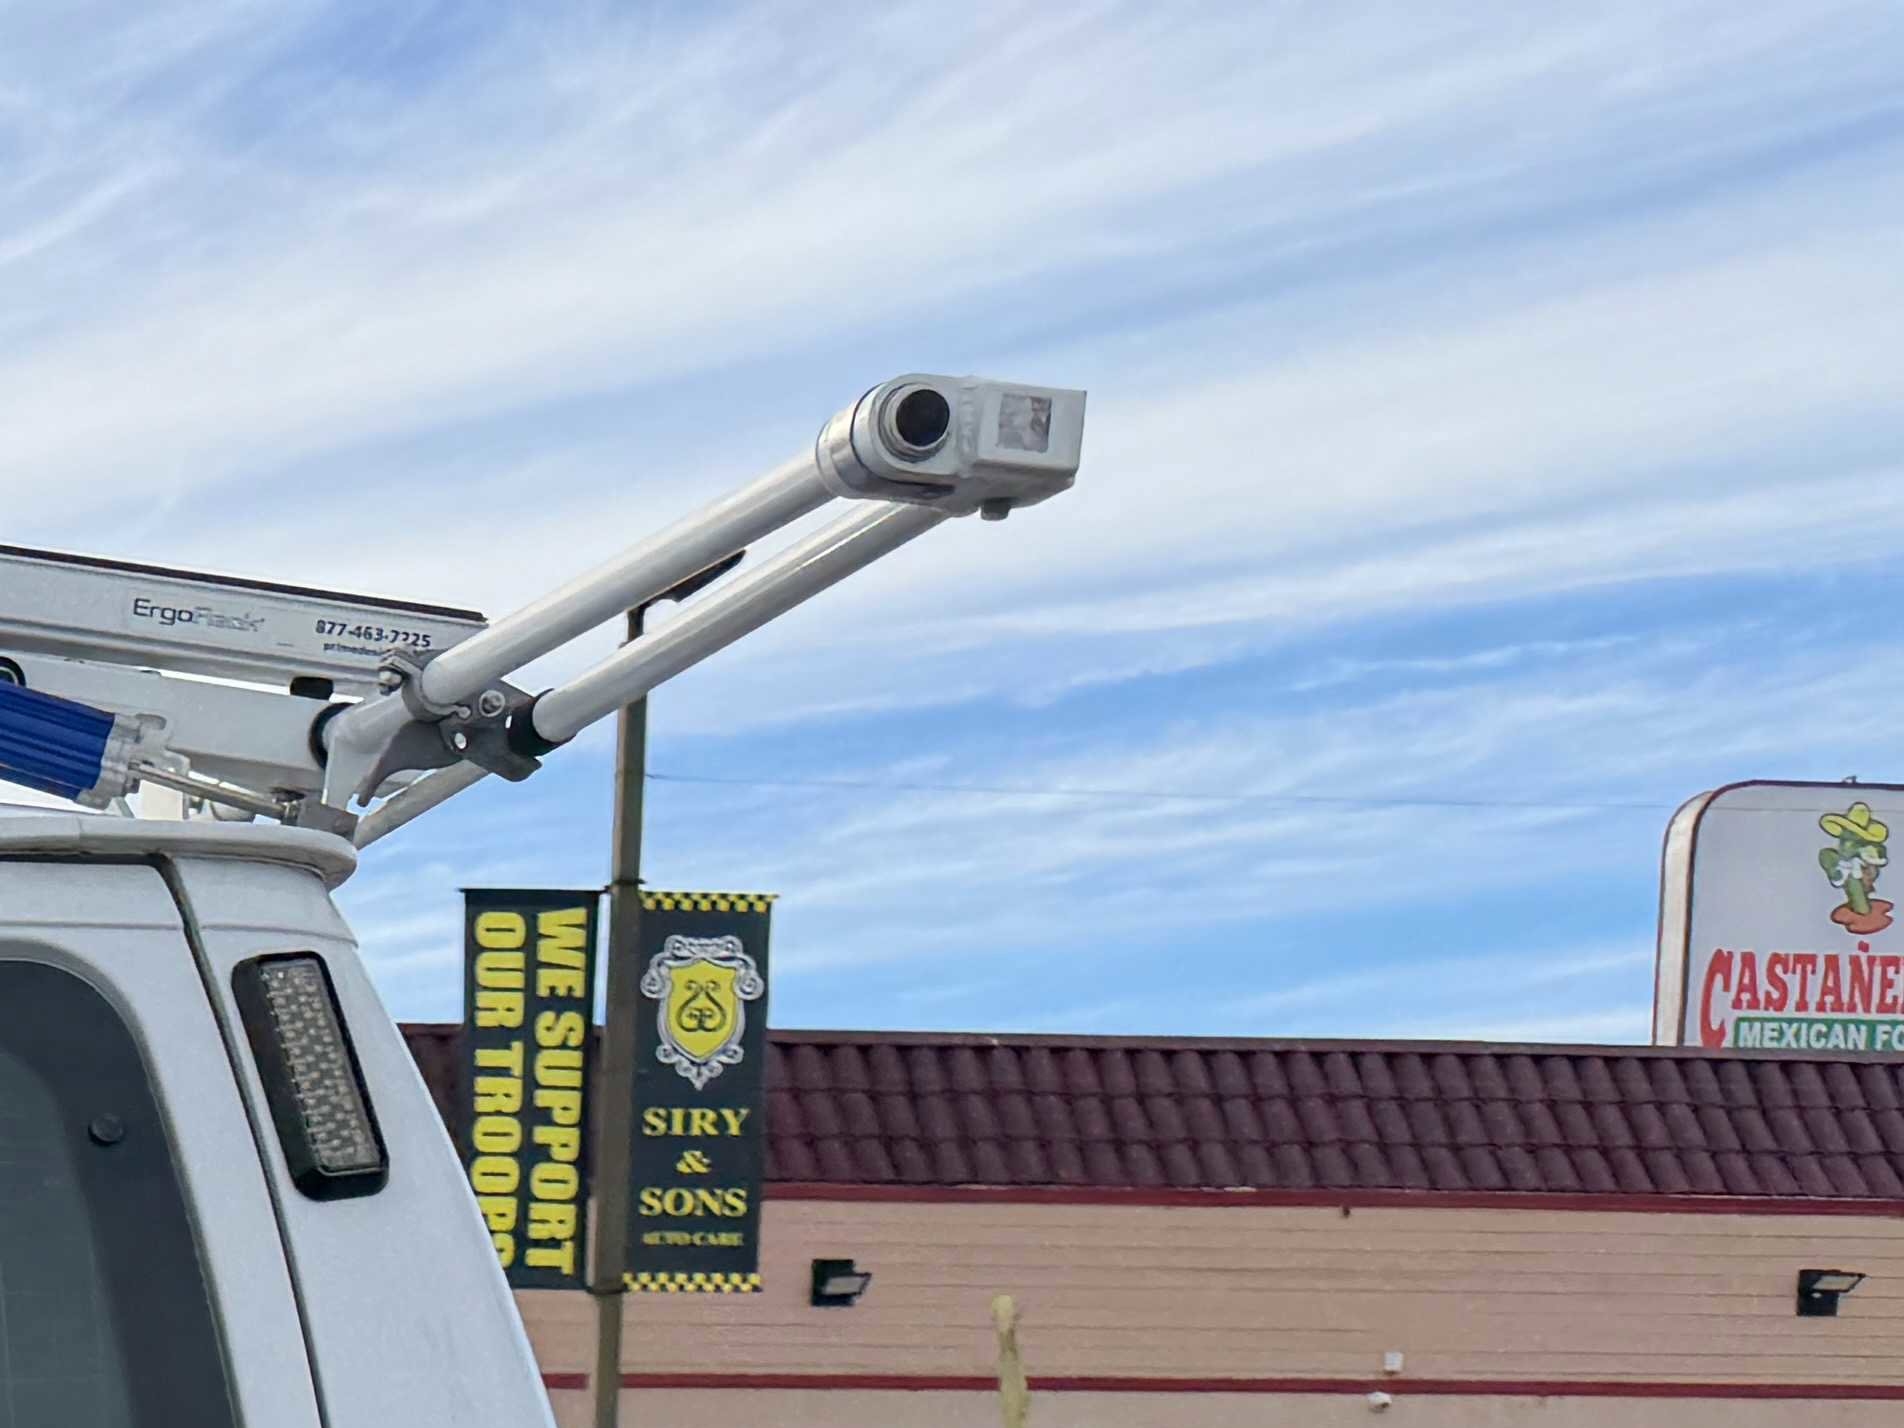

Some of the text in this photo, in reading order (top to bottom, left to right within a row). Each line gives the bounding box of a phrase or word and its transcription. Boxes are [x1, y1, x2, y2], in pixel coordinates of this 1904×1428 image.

[133, 598, 265, 633] ErgoRack
[315, 619, 432, 648] 877-463-7225
[473, 911, 526, 1029] OUR
[1699, 940, 1904, 1050] CASTAÑE
[1738, 1021, 1866, 1050] MEXICAN
[524, 907, 588, 1276] WE SUPPORT
[642, 1107, 751, 1137] SIRY
[676, 1150, 712, 1174] &
[639, 1187, 748, 1217] SONS
